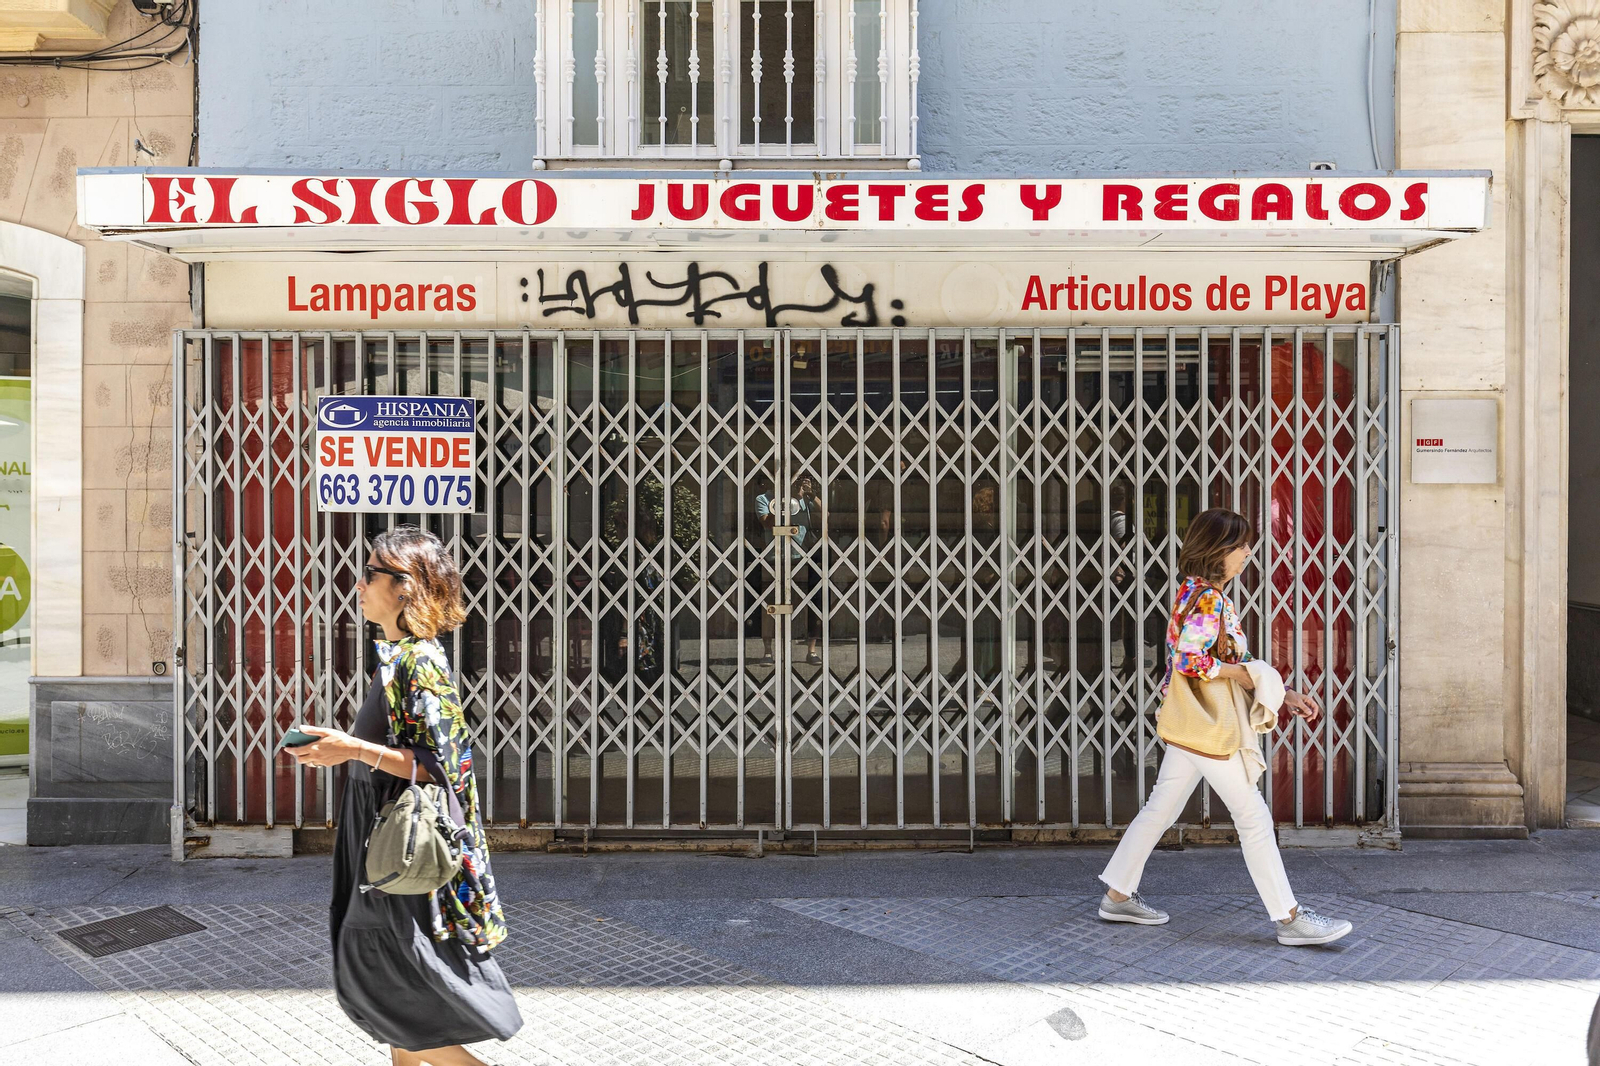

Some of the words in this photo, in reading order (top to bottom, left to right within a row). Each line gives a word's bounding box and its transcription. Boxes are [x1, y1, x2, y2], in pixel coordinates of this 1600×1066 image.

[147, 177, 258, 223] EL
[292, 178, 558, 226] SIGLO
[631, 183, 986, 221] JUGUETES
[1020, 184, 1062, 221] Y
[1102, 182, 1428, 221] REGALOS
[288, 275, 477, 320] Lamparas
[1021, 275, 1192, 312] Articulos
[1206, 275, 1251, 312] de
[1265, 275, 1366, 320] Playa
[373, 418, 410, 429] agencia
[411, 418, 471, 428] inmobiliaria
[375, 401, 470, 417] HISPANIA
[319, 436, 354, 467] SE
[363, 436, 471, 468] VENDE
[320, 473, 360, 505] 663
[368, 474, 415, 506] 370
[423, 474, 472, 506] 075
